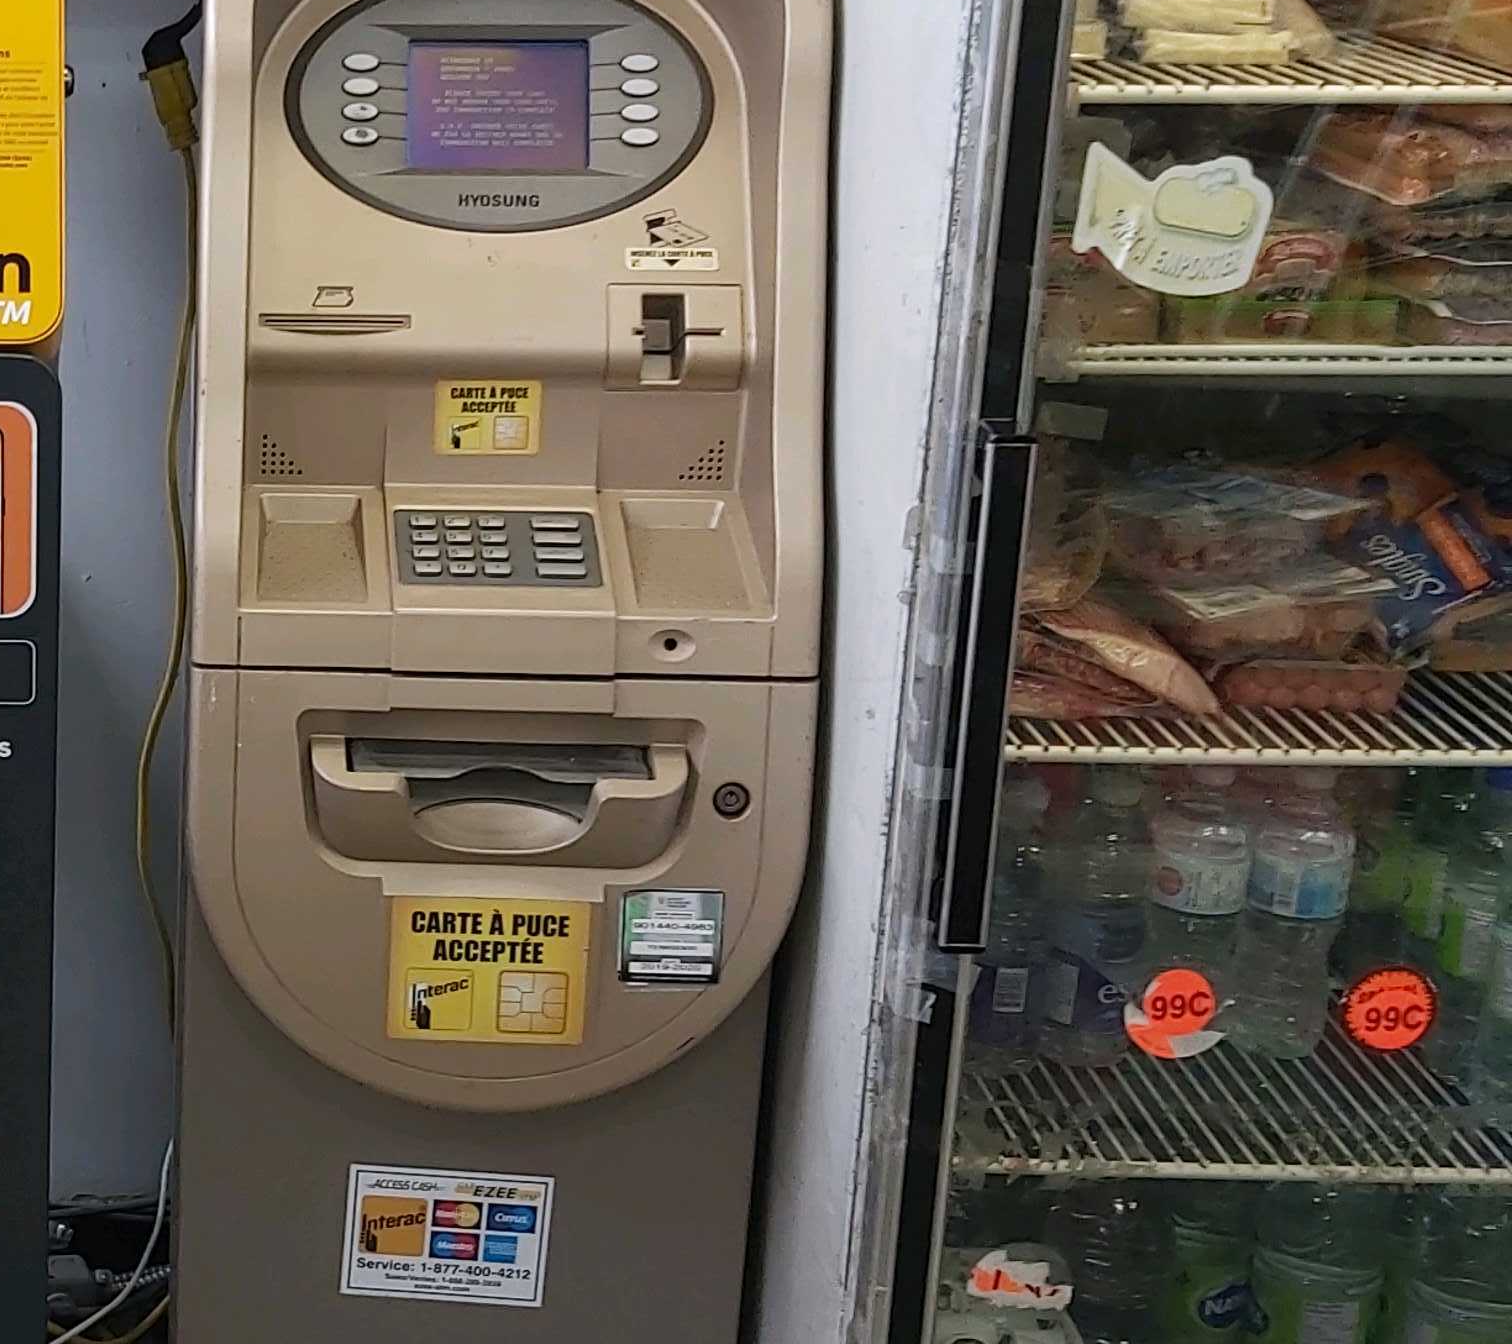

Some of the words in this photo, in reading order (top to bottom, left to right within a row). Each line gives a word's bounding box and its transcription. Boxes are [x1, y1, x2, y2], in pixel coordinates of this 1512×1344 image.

[458, 193, 541, 208] HYOSUNG
[450, 387, 486, 399] CARTE
[500, 387, 529, 399] PUCE
[411, 911, 483, 935] CARTE
[490, 909, 504, 936] À
[512, 913, 570, 937] PUCE
[433, 937, 544, 964] ACCEPTÉE
[411, 977, 470, 1009] Interac
[473, 1185, 518, 1199] EZEE
[361, 1211, 426, 1232] Interac
[356, 1257, 415, 1272] Service:
[421, 1262, 531, 1280] 1-877-400-4212
